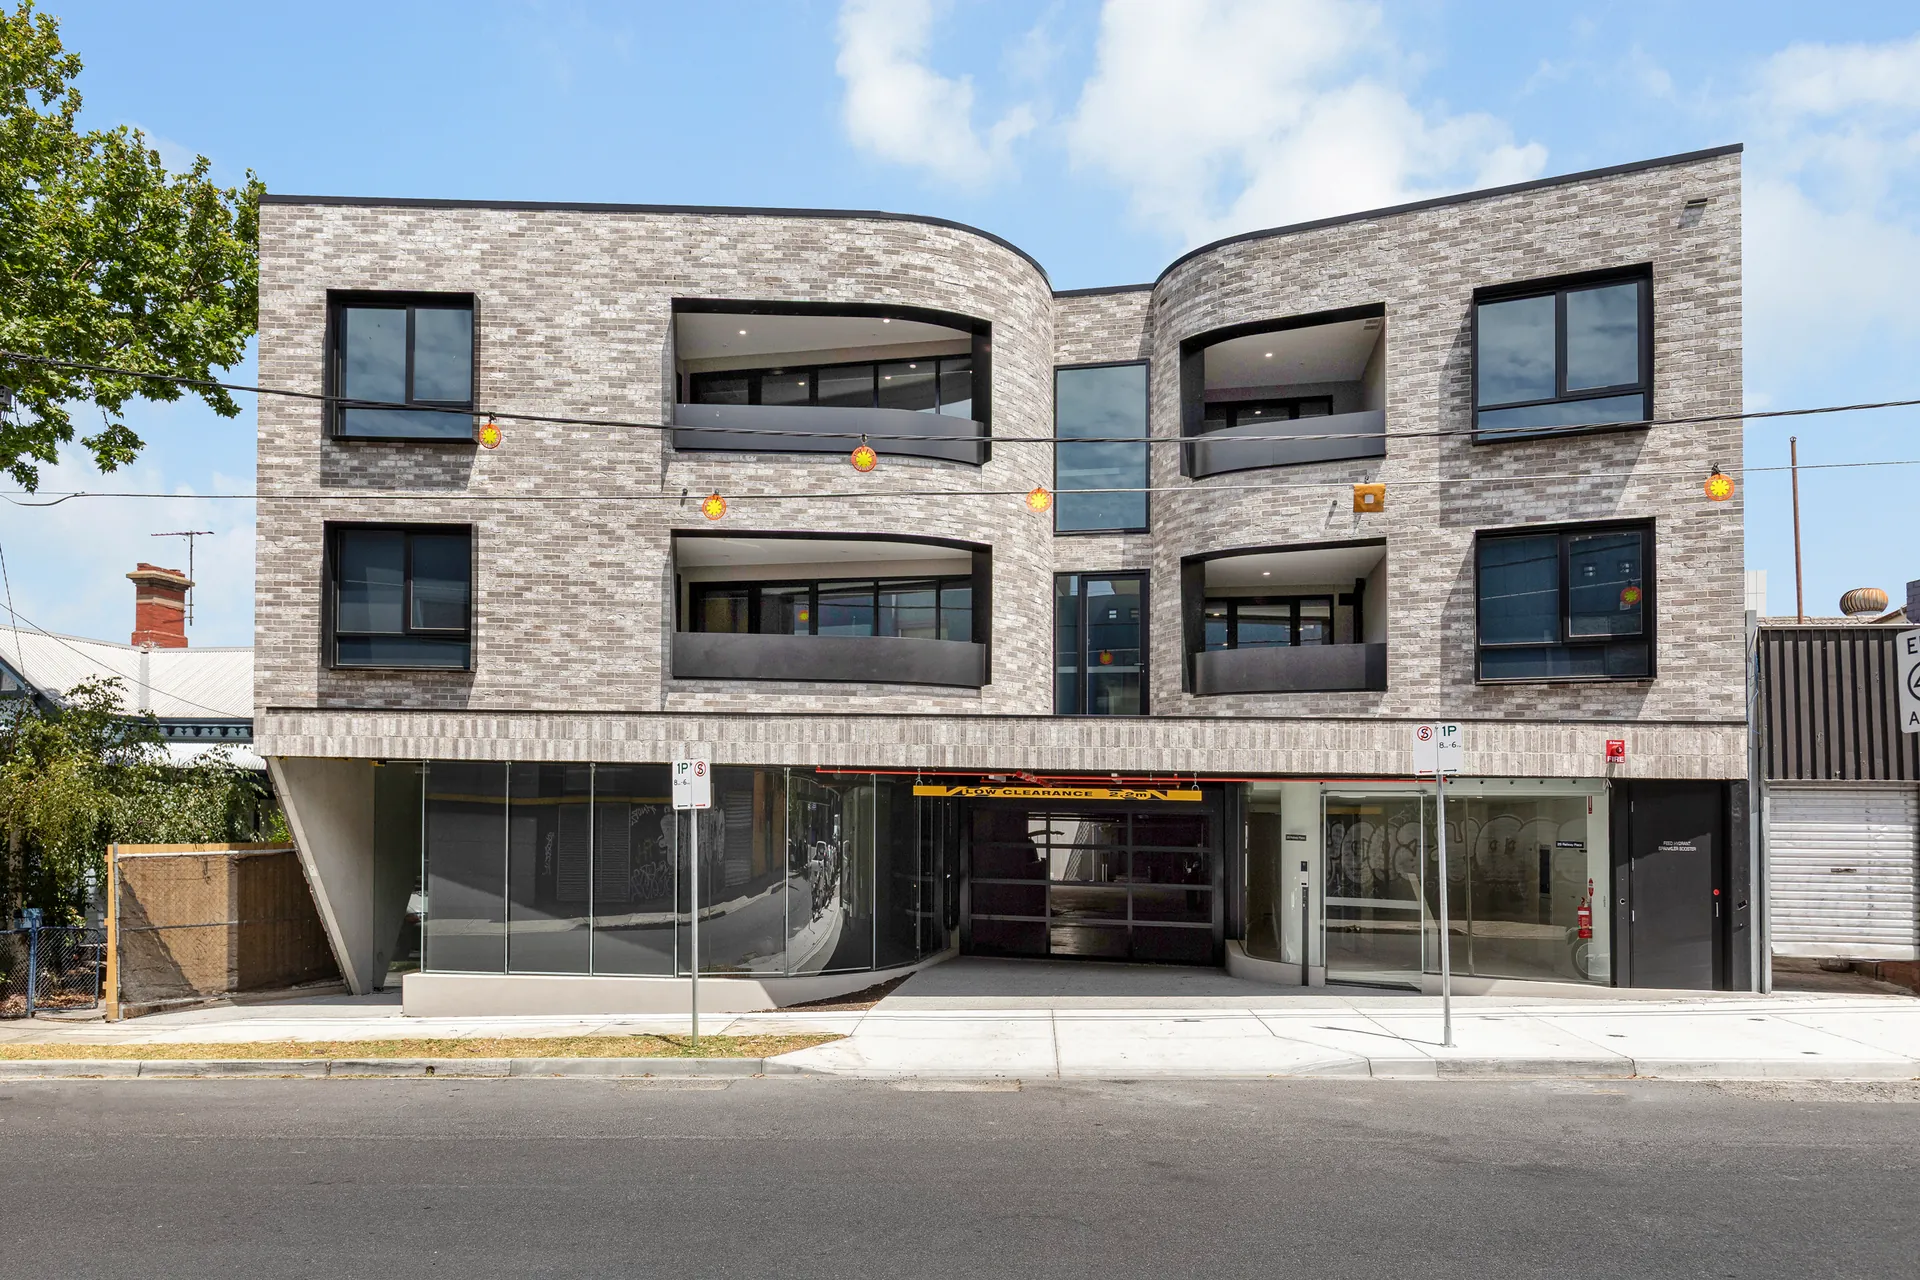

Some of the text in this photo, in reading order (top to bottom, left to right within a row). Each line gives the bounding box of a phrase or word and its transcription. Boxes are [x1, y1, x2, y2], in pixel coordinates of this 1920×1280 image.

[1907, 636, 1920, 655] E
[1909, 711, 1920, 725] A
[1442, 725, 1457, 736] 1P
[677, 762, 688, 775] 1P
[1003, 789, 1093, 797] CLEARANCE
